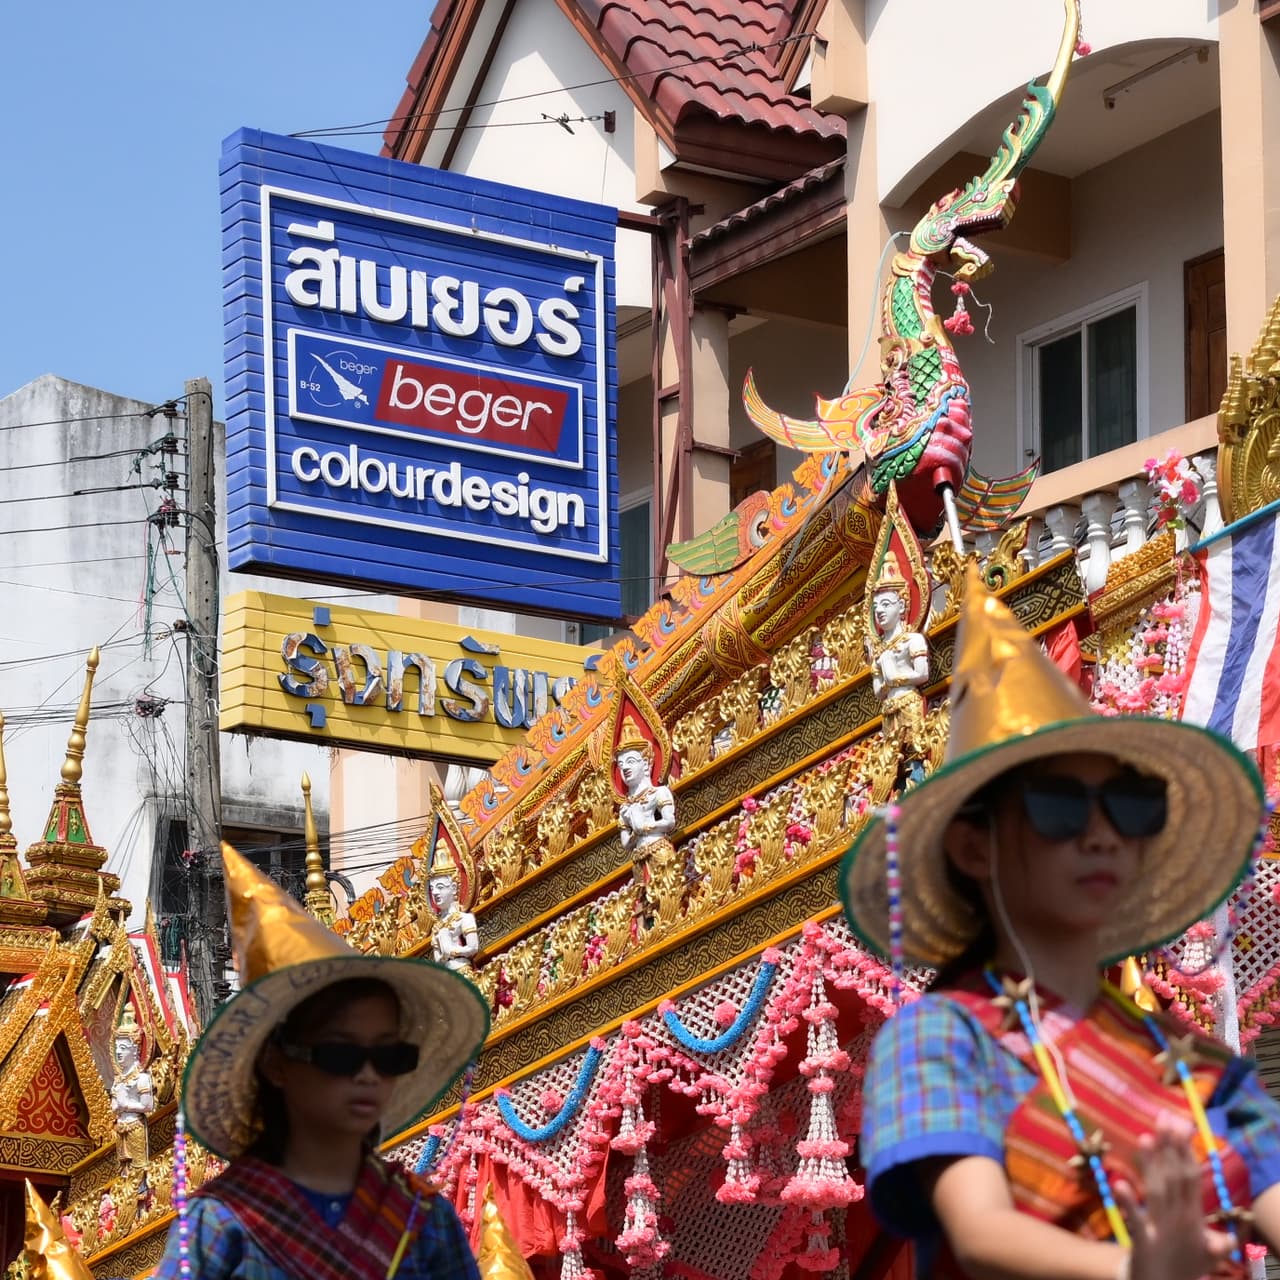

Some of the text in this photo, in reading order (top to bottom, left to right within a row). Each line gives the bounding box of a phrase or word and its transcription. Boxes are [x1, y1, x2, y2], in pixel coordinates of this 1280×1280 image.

[285, 219, 585, 358] สีเบเยอร์
[299, 380, 322, 393] B-52
[339, 357, 379, 375] beger
[388, 364, 552, 434] beger
[291, 444, 586, 535] colourdesign
